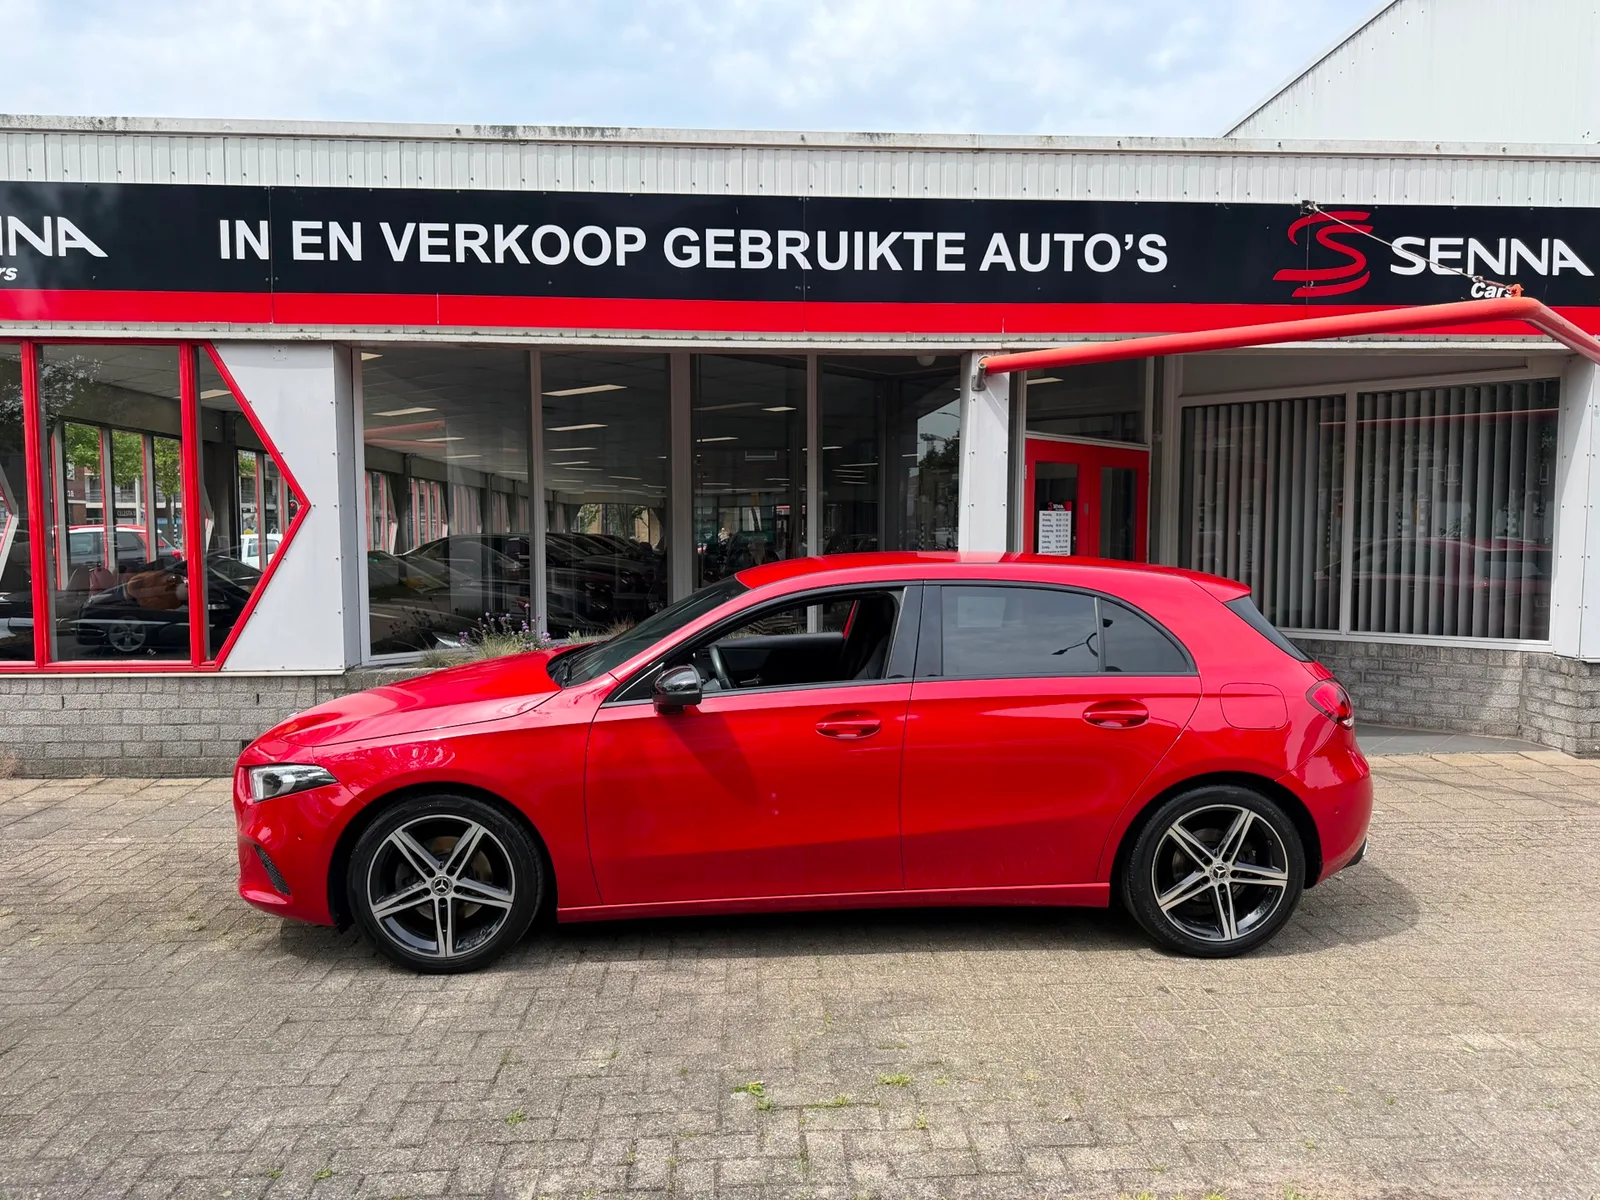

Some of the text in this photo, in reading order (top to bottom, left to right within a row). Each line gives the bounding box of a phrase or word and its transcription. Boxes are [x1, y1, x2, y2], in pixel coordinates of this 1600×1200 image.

[0, 216, 108, 257] NA
[220, 220, 1168, 273] IN EN VERKOOP GEBRUIKTE AUTO'S
[1390, 236, 1594, 277] SENNA
